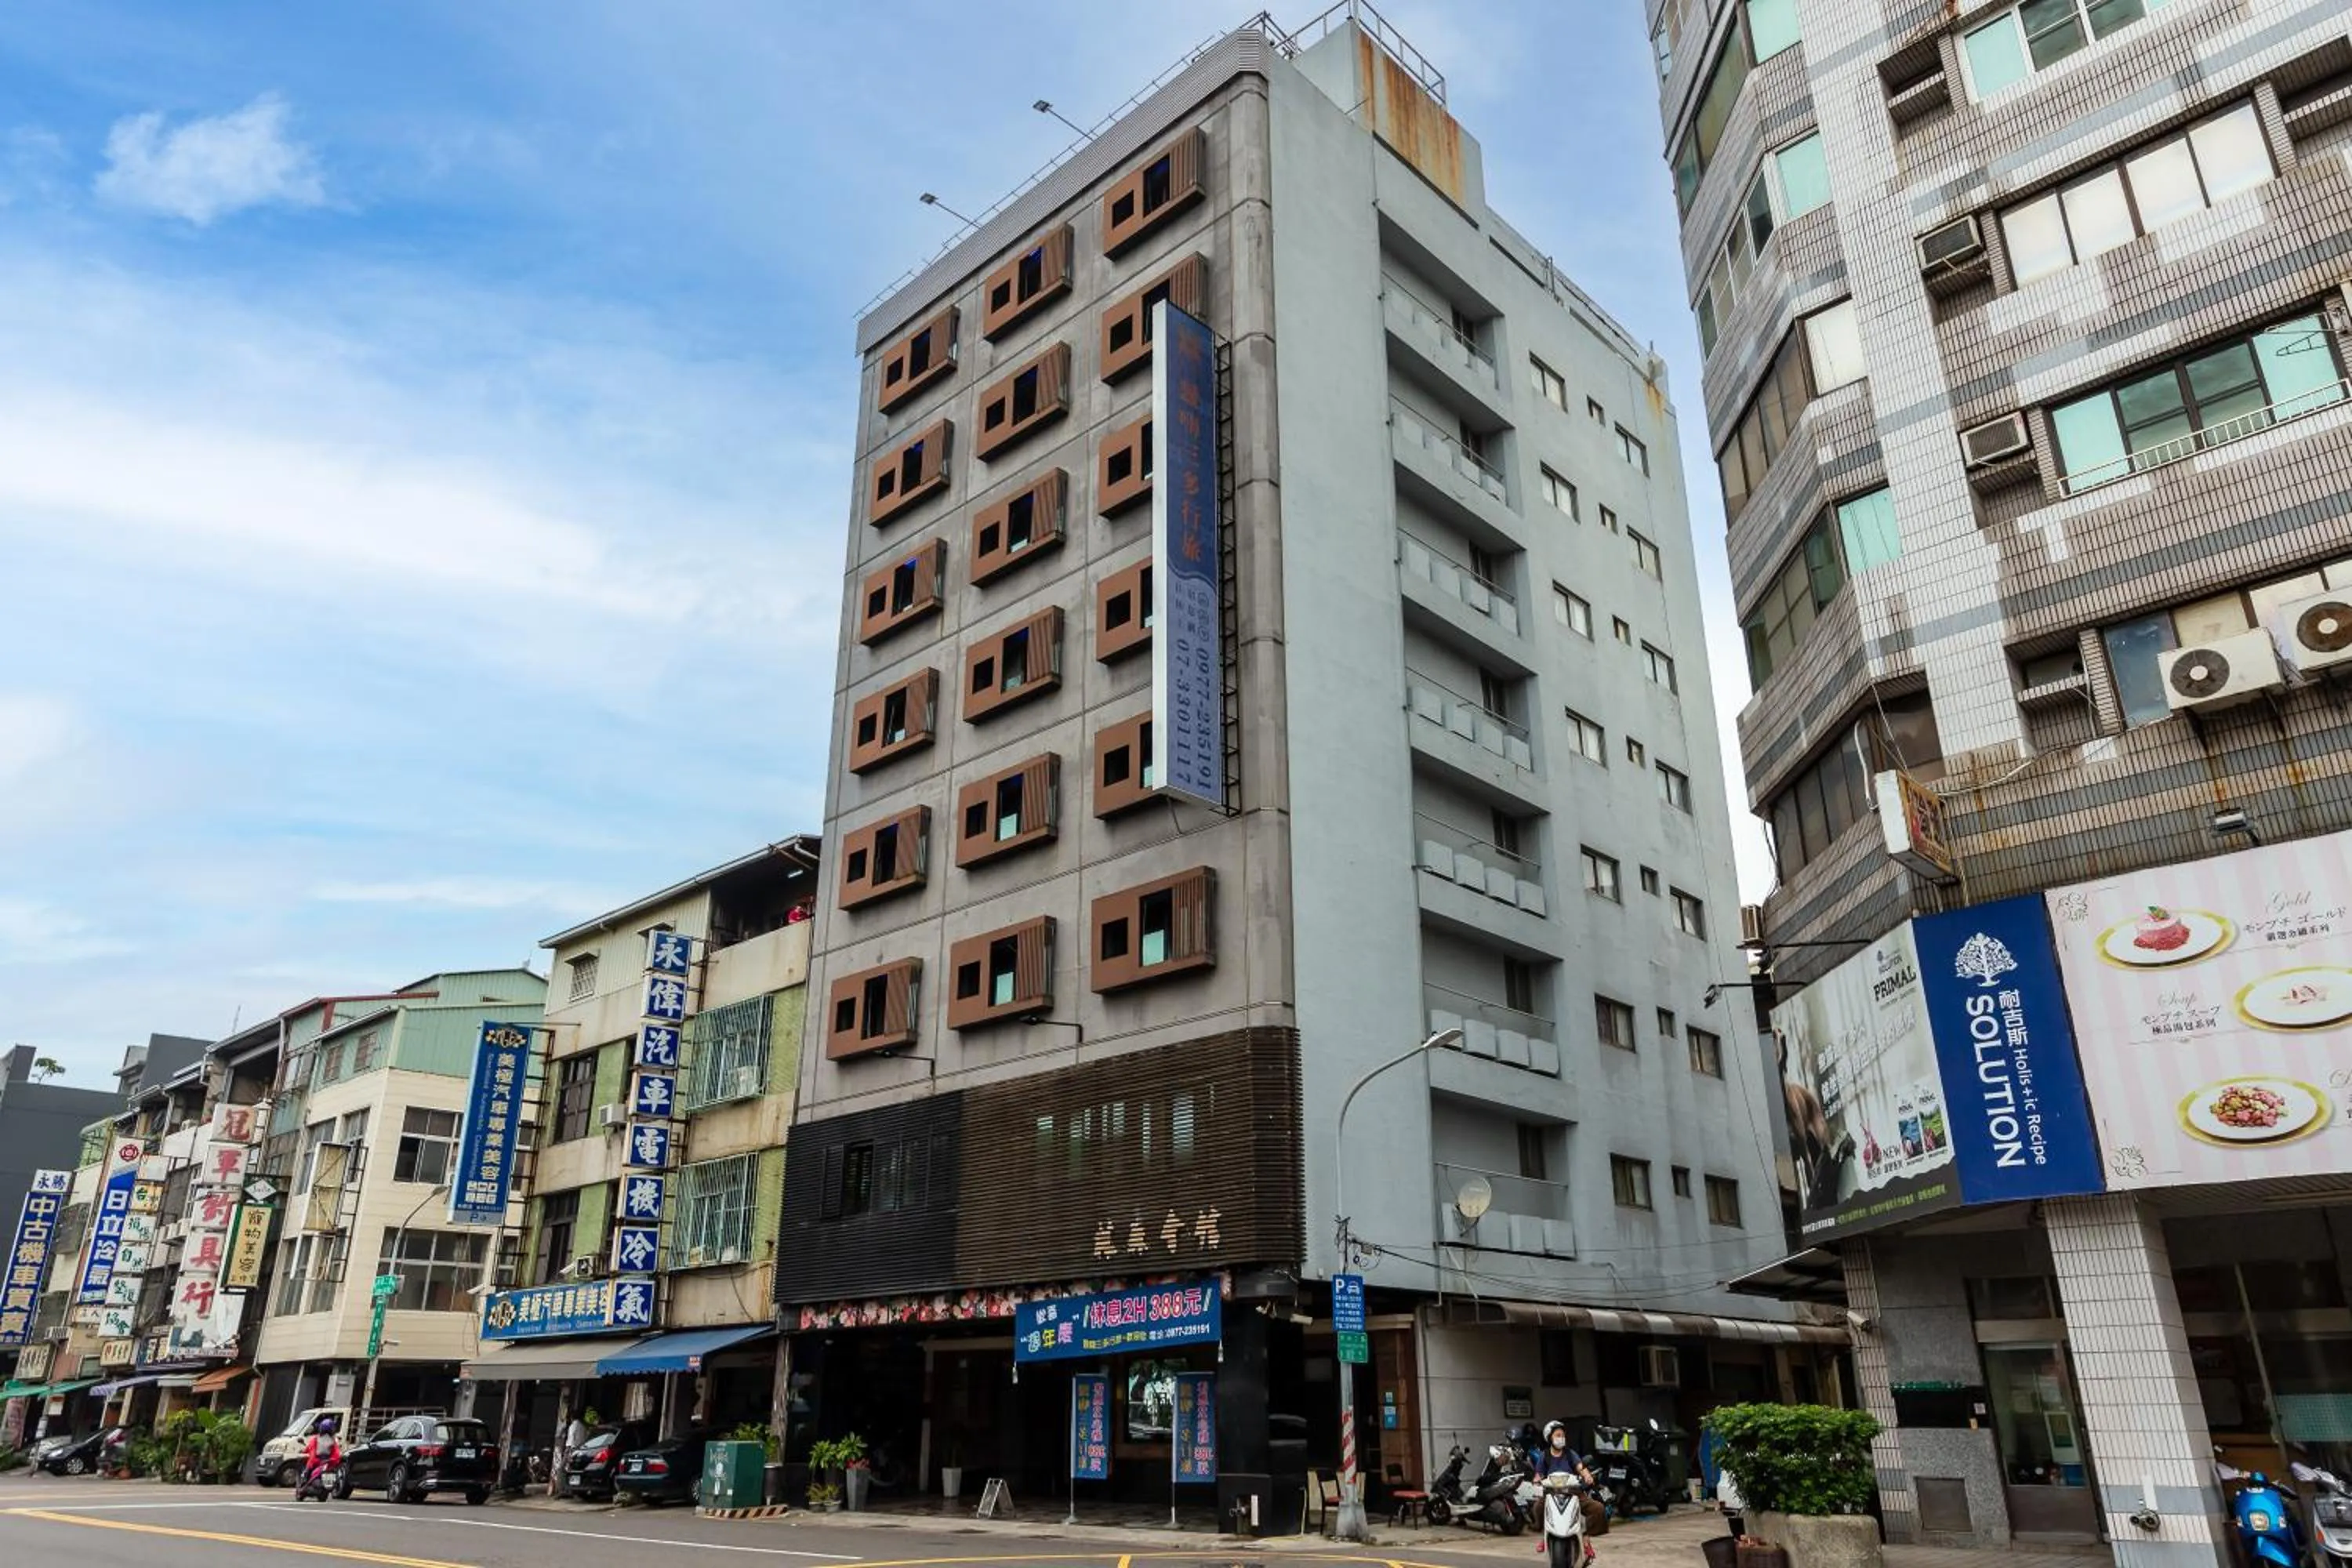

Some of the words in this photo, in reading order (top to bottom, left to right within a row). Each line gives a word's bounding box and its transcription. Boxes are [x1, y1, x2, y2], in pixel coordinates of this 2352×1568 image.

[1176, 639, 1191, 784] 07-3301117
[1197, 648, 1211, 790] 0977-235191
[1873, 965, 1917, 1002] PRIMAL
[615, 937, 684, 1322] 永偉汽車電機冷氣
[1965, 994, 2027, 1168] SOLUTION
[1998, 989, 2028, 1047] 耐吉斯
[2027, 1114, 2047, 1166] Recipe
[38, 1173, 67, 1190] 永勝
[87, 1189, 129, 1285] 日立冷氣
[1335, 1278, 1345, 1294] P
